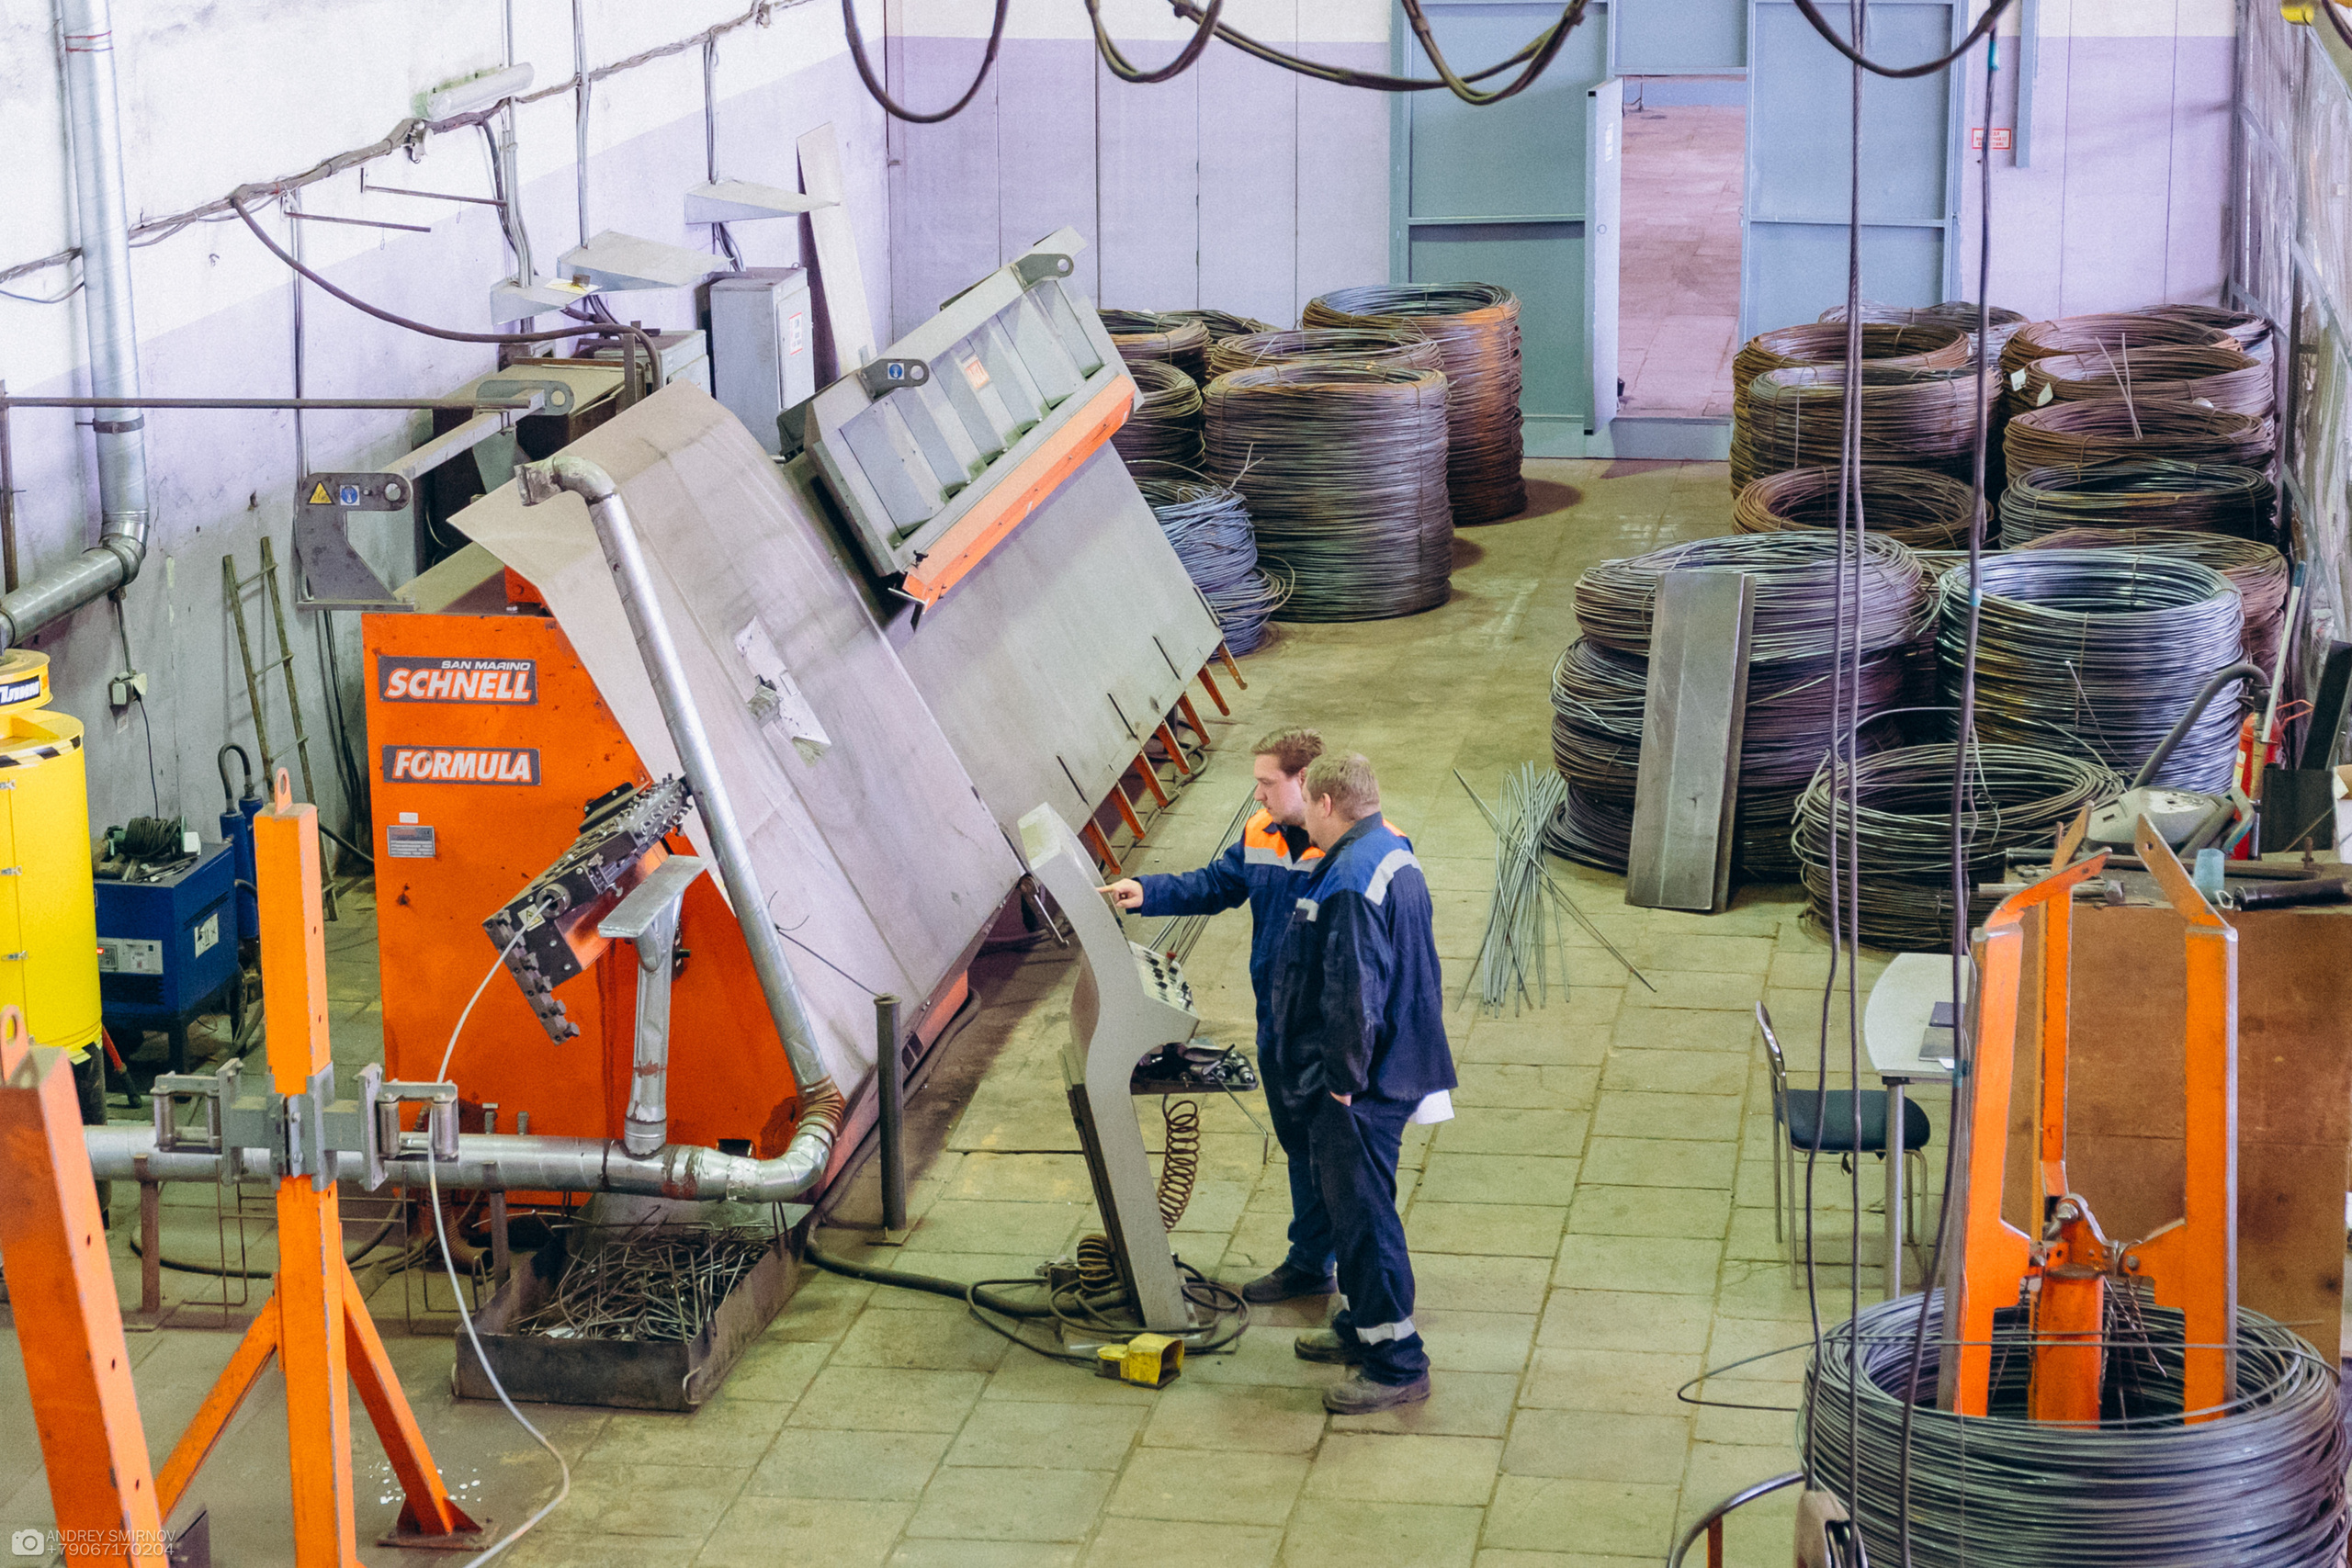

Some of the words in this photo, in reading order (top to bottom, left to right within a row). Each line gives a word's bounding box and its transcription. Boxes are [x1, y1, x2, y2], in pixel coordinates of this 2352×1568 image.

[441, 660, 472, 670] SAN
[474, 661, 531, 671] MARINO
[386, 668, 532, 701] SCHNELL
[393, 750, 532, 782] FORMULA
